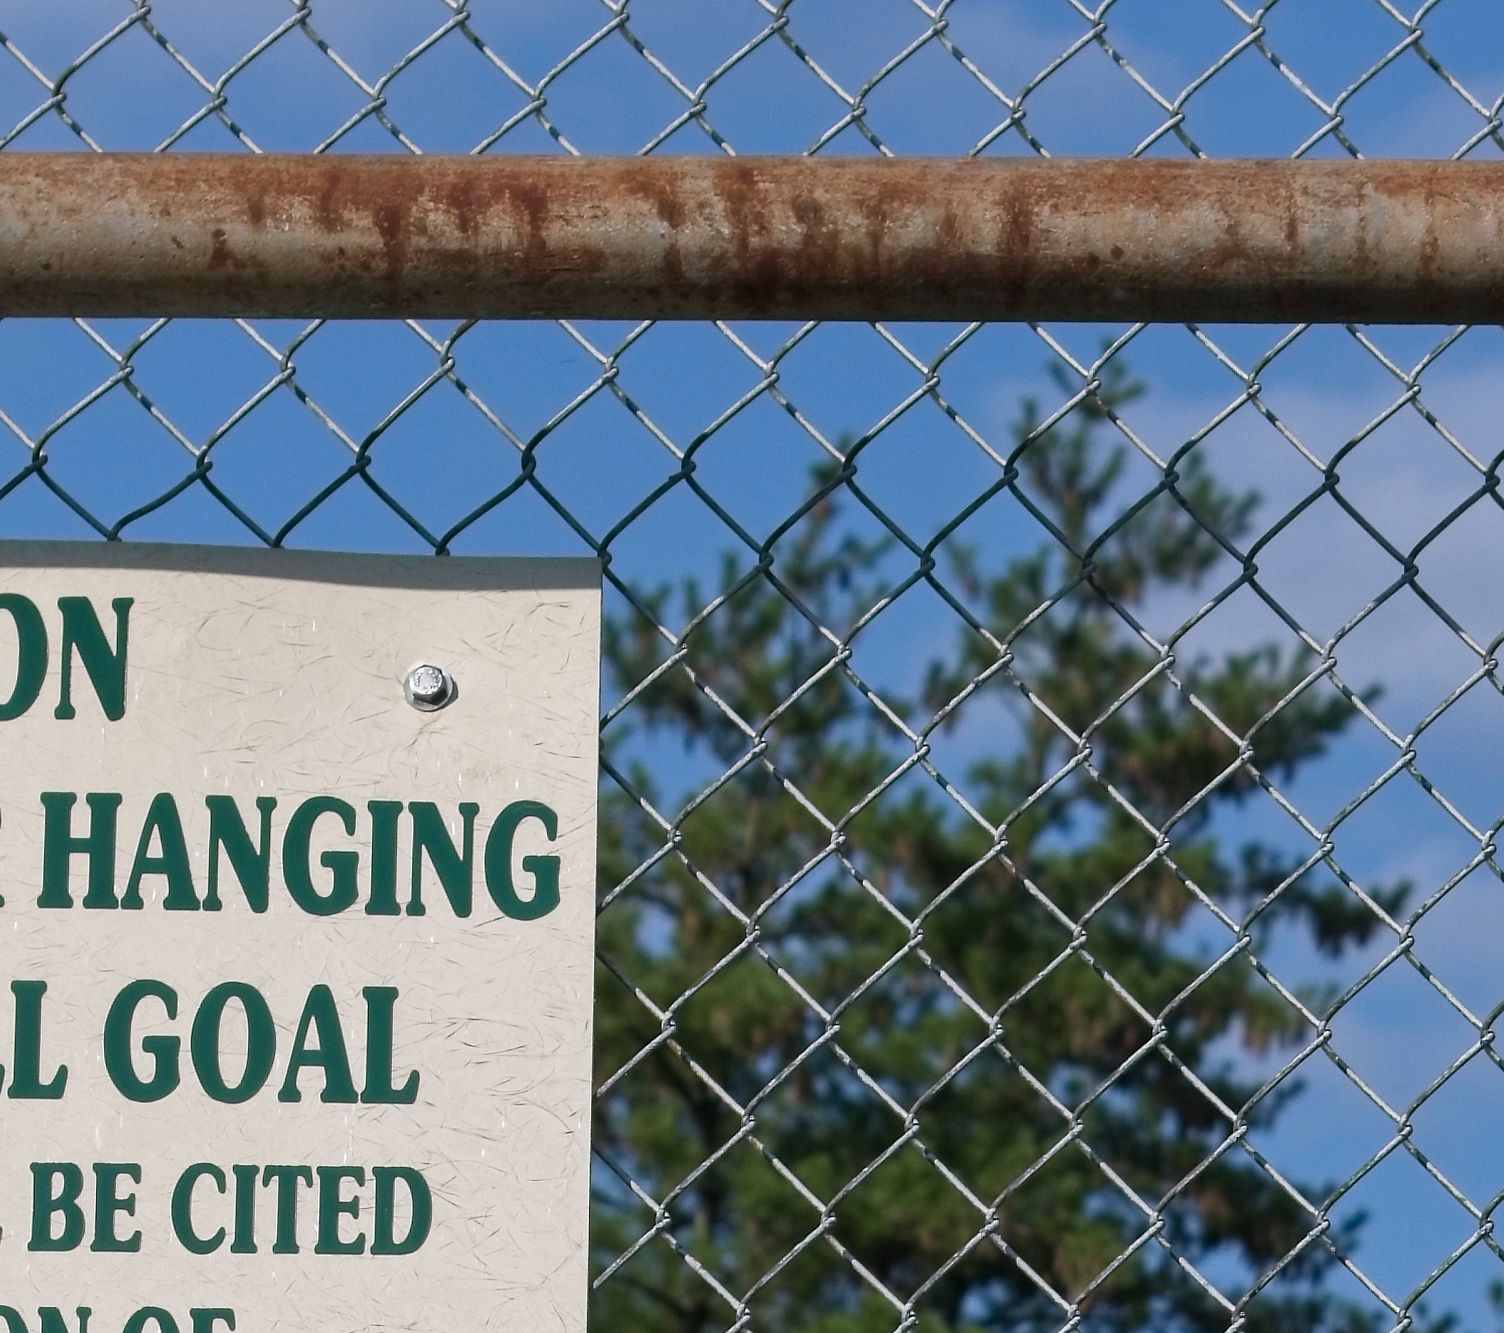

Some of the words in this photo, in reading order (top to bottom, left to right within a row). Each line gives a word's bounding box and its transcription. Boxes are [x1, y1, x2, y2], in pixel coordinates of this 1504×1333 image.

[36, 790, 561, 921] HANGING
[102, 978, 419, 1105] GOAL
[26, 1162, 142, 1252] BE
[171, 1162, 432, 1255] CITED
